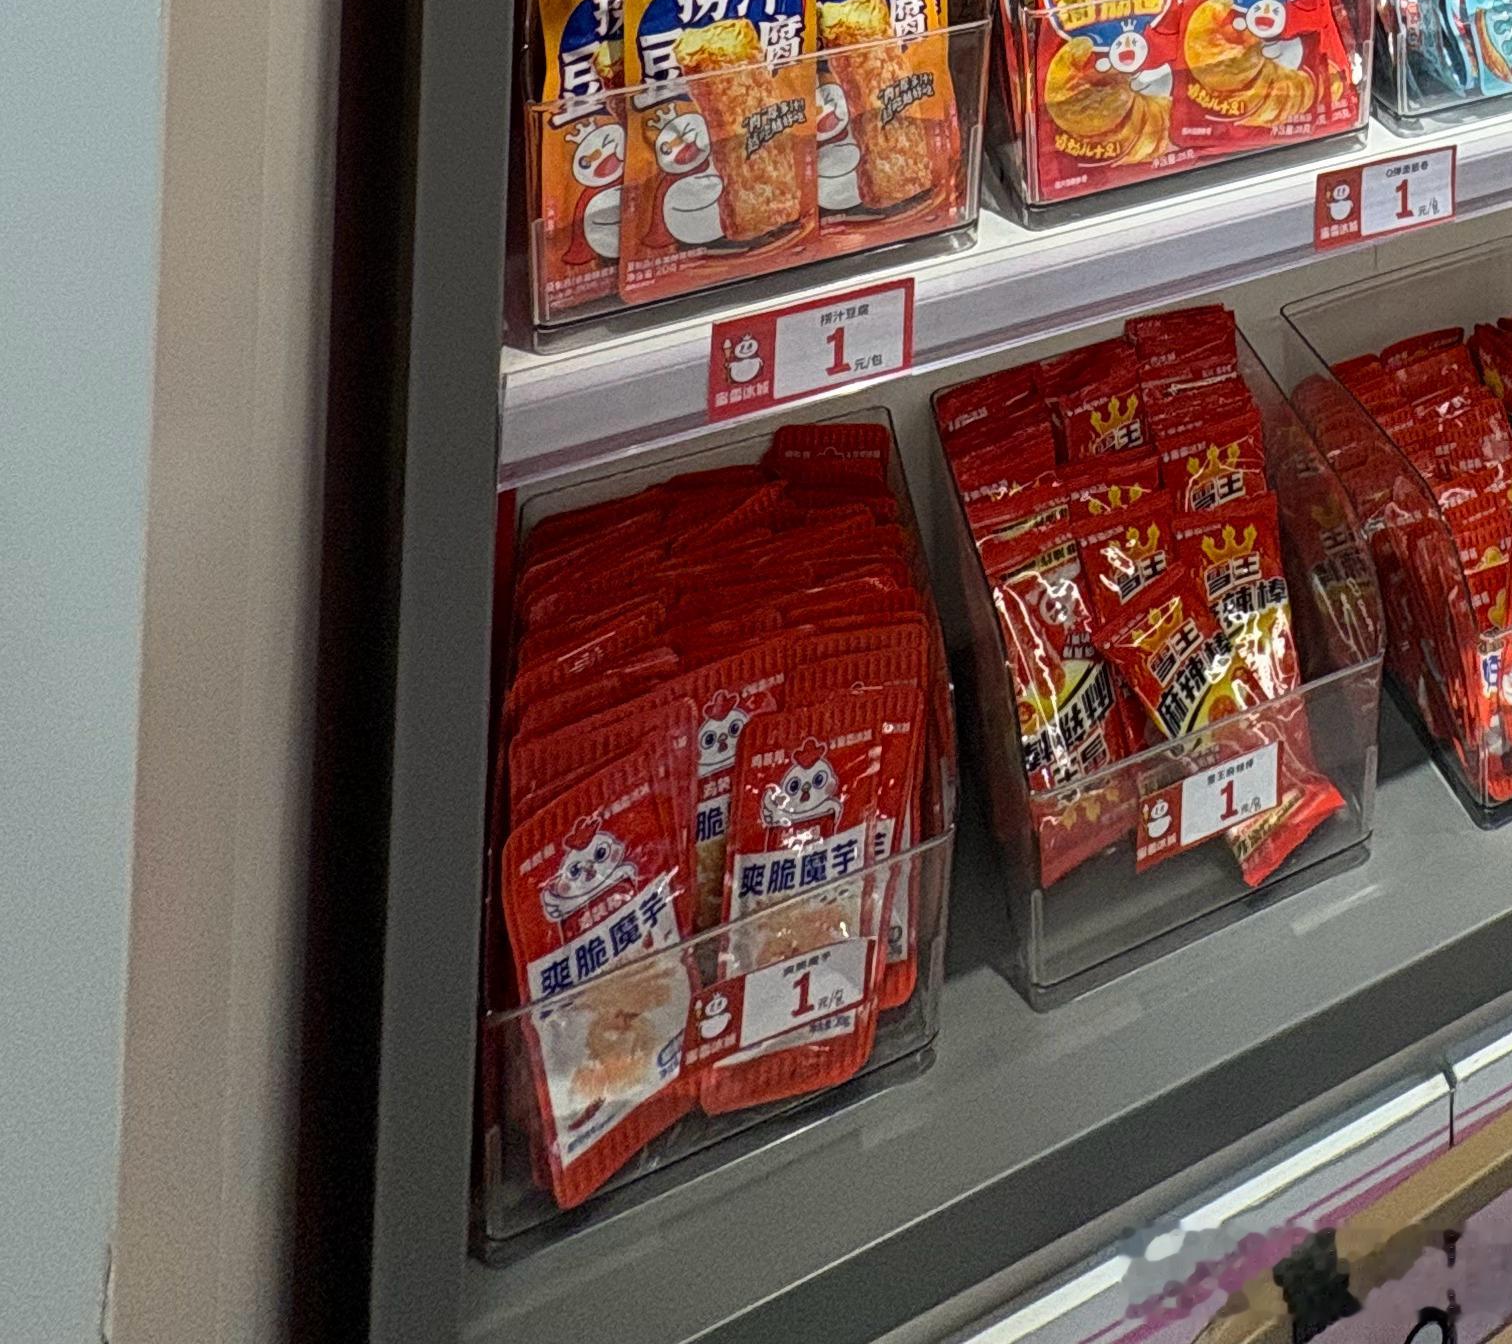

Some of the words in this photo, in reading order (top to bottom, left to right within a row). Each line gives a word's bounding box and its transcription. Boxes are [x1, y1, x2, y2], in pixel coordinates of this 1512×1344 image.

[1394, 178, 1414, 220] 1
[820, 303, 870, 326] 捞汁豆腐
[826, 326, 852, 377] 1
[1190, 468, 1247, 511] 雪王
[1118, 550, 1167, 600] 雪王
[1203, 550, 1263, 595] 雪王
[1148, 617, 1202, 684] 雪王
[1156, 628, 1233, 736] 麻辣棒
[1218, 779, 1239, 822] 1
[738, 838, 858, 900] 爽脆魔芋
[538, 889, 668, 997] 爽脆魔芋
[791, 971, 815, 1018] 1
